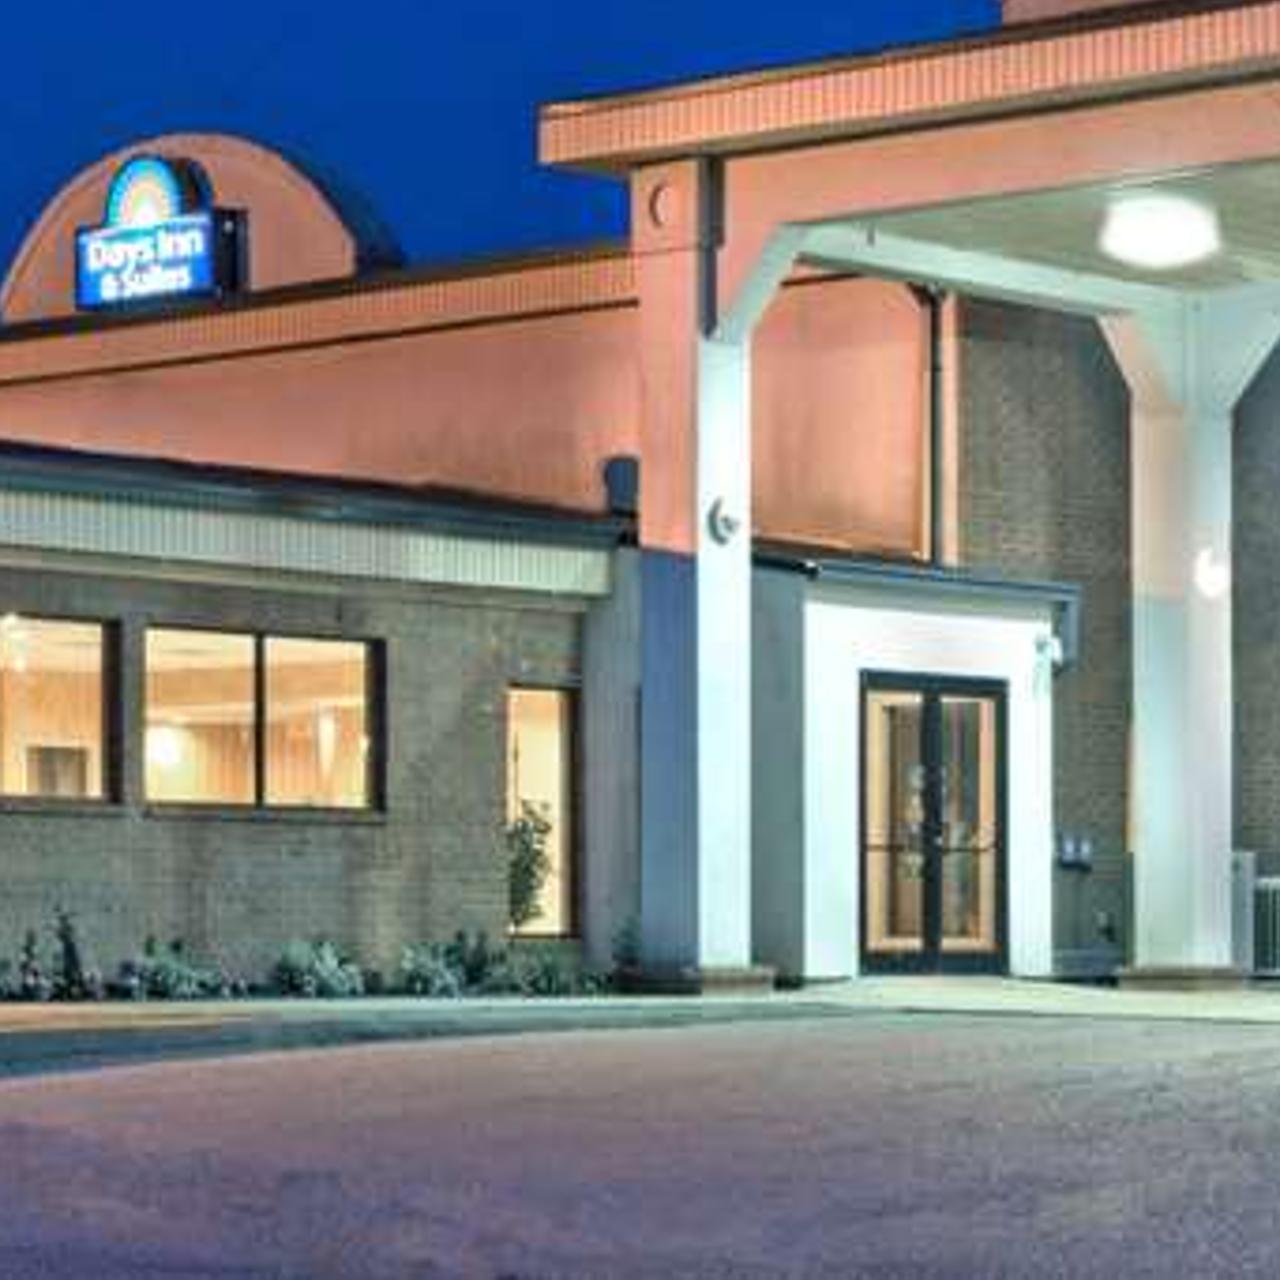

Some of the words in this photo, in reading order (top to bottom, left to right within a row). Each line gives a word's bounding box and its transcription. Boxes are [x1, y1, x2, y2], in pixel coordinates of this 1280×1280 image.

[86, 233, 155, 276] Days
[156, 226, 204, 262] Inn
[122, 265, 192, 297] Suites
